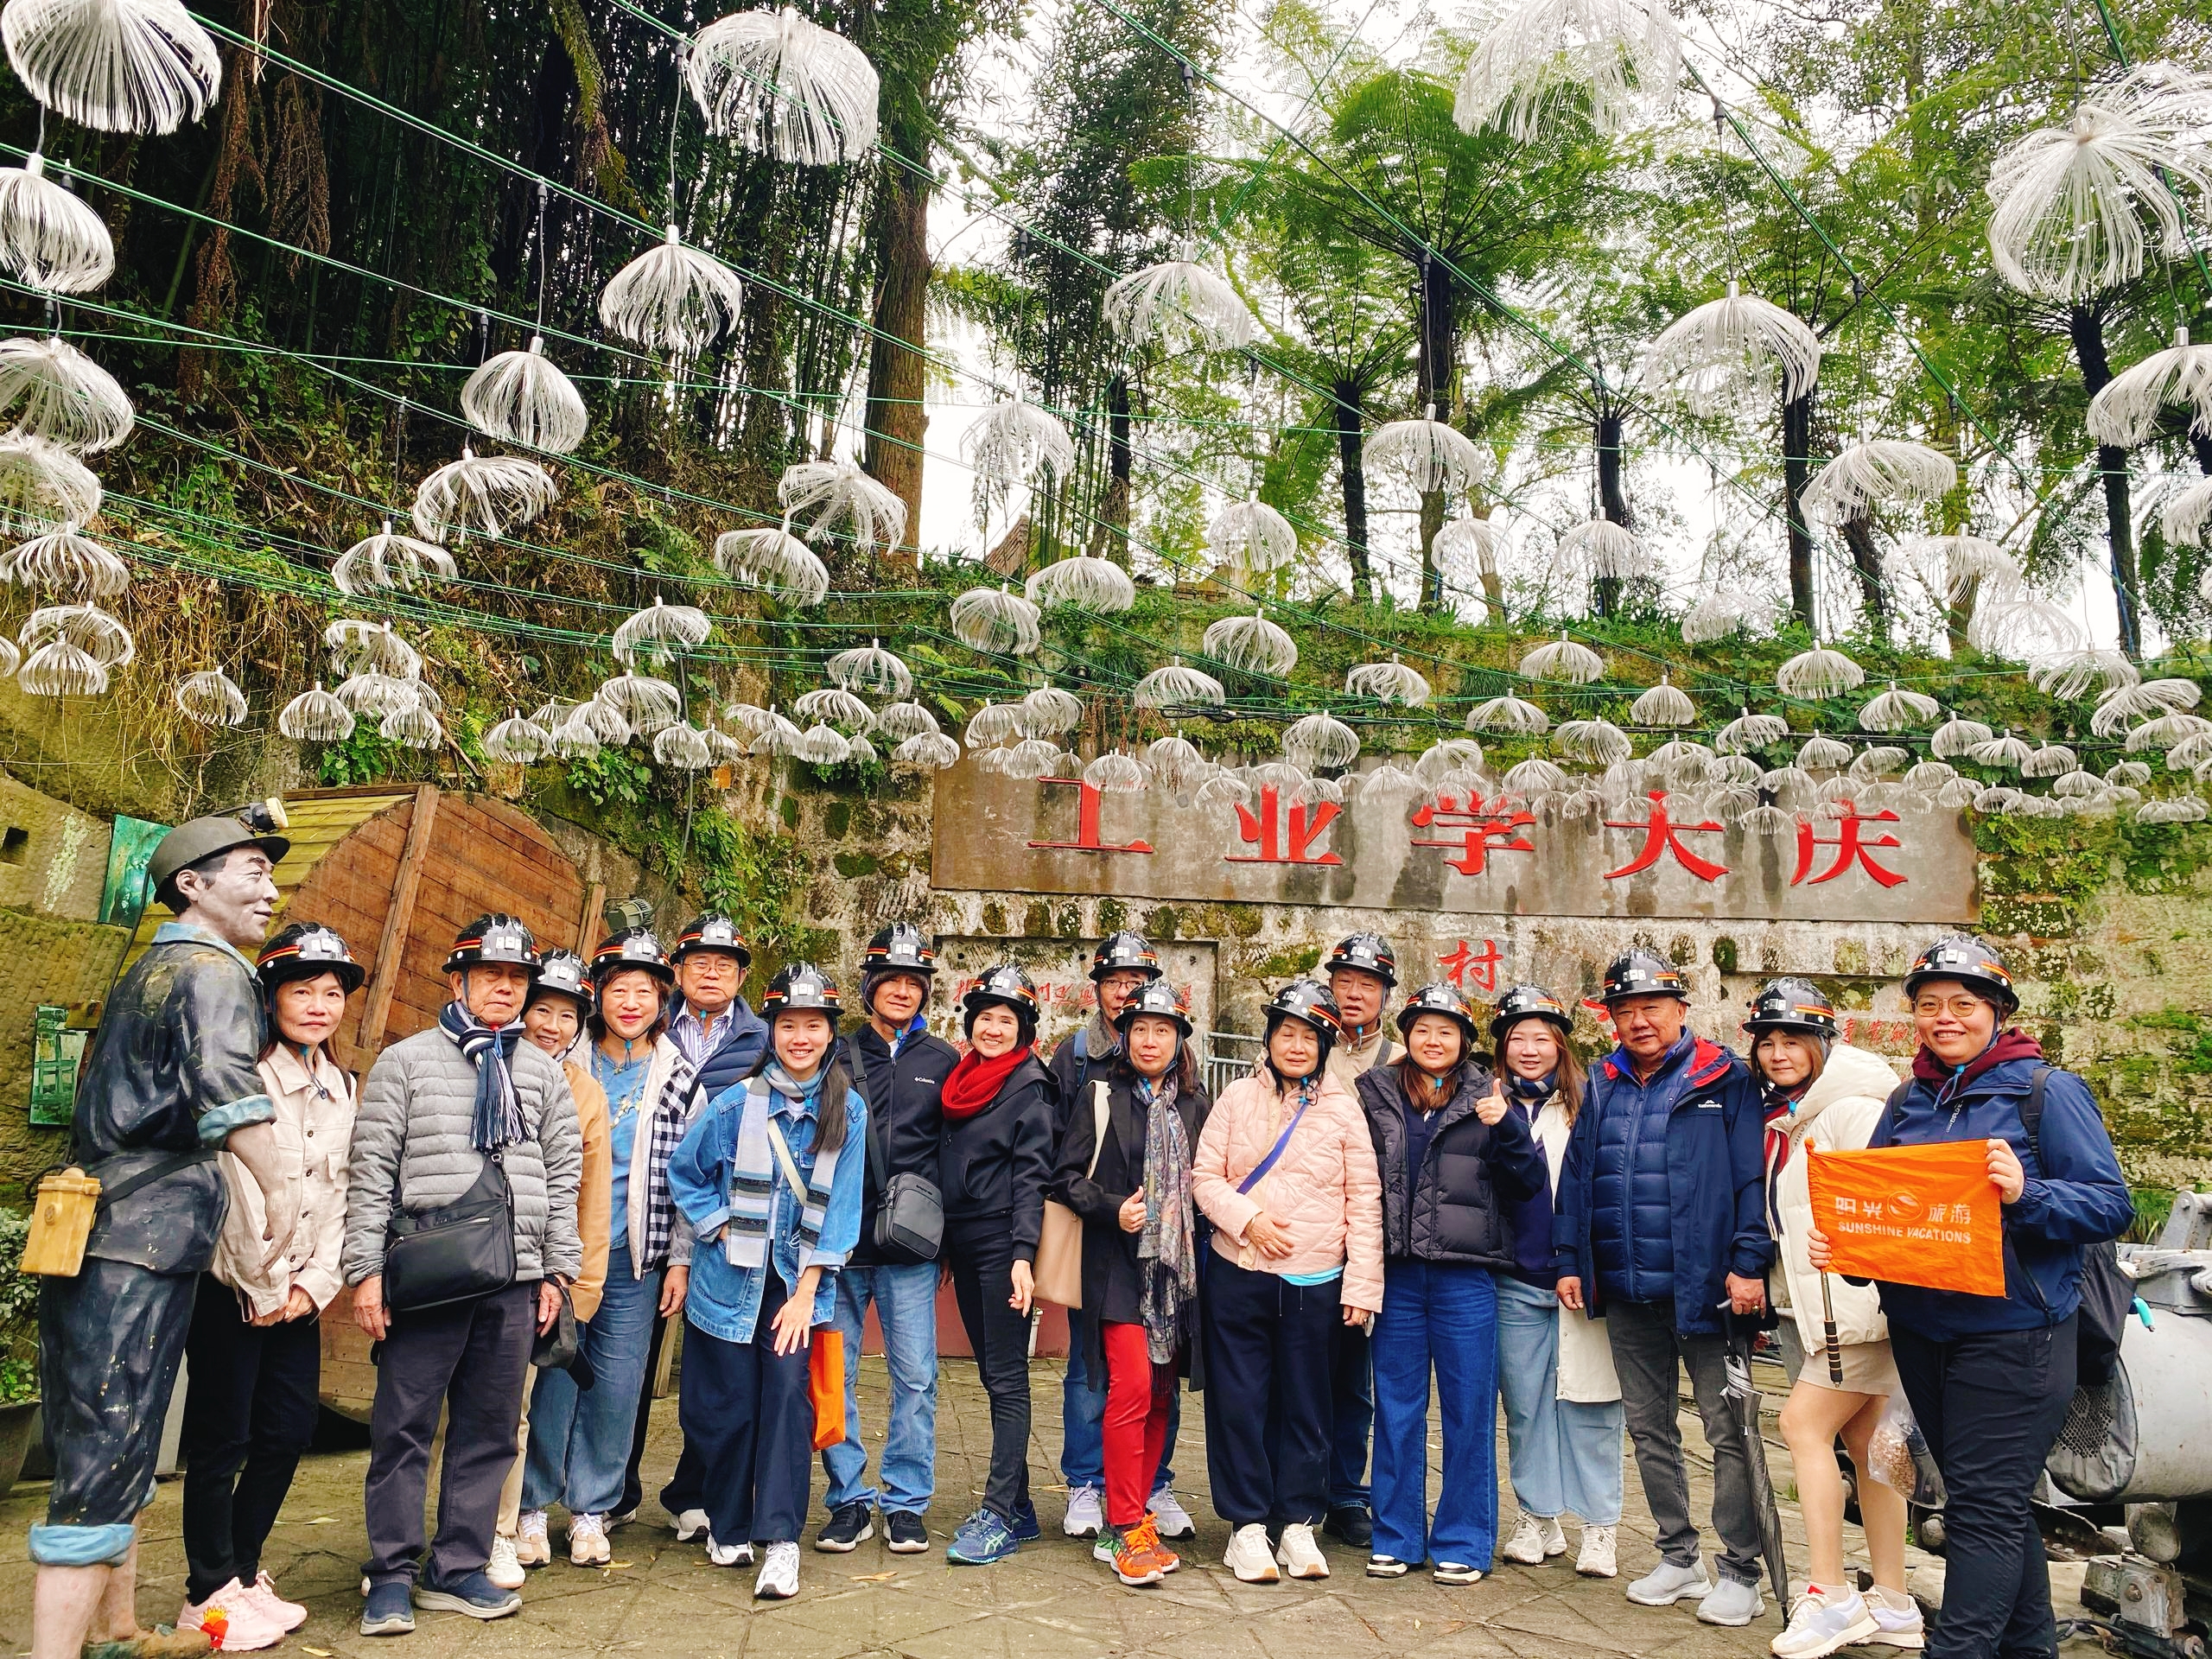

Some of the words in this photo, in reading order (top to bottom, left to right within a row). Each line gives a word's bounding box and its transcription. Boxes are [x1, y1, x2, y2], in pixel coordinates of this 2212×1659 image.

[1027, 776, 1909, 888] 工业学大庆
[1440, 939, 1504, 992] 村
[1838, 1221, 1904, 1237] SUNSHINE
[1906, 1227, 1972, 1244] VACATIONS
[1927, 1203, 1972, 1224] 旅游
